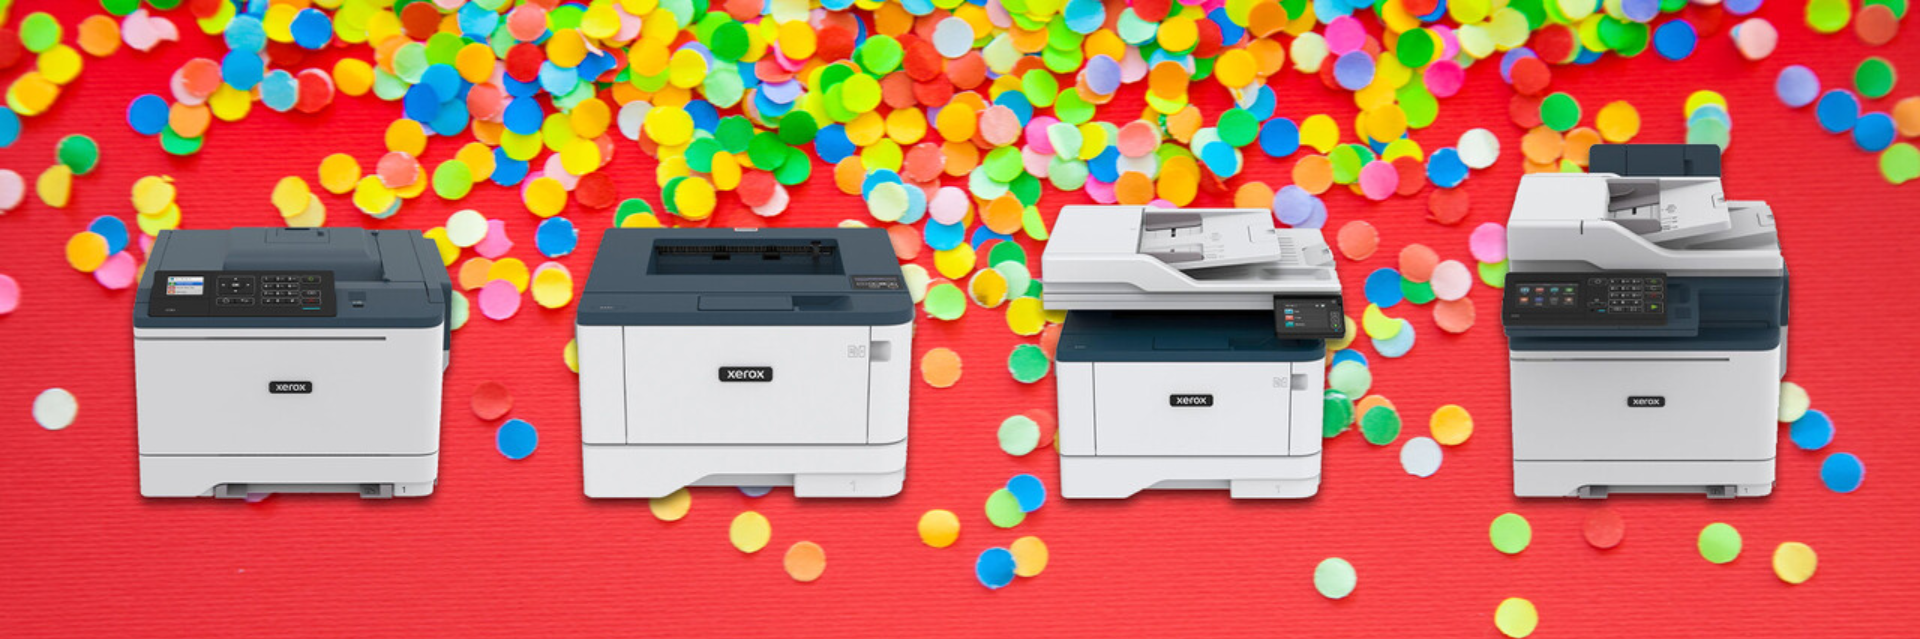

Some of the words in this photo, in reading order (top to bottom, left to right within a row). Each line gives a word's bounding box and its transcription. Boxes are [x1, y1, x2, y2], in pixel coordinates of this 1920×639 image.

[727, 370, 765, 379] xerox
[275, 384, 307, 392] xerox
[1176, 396, 1207, 405] xerox
[849, 480, 856, 492] 1
